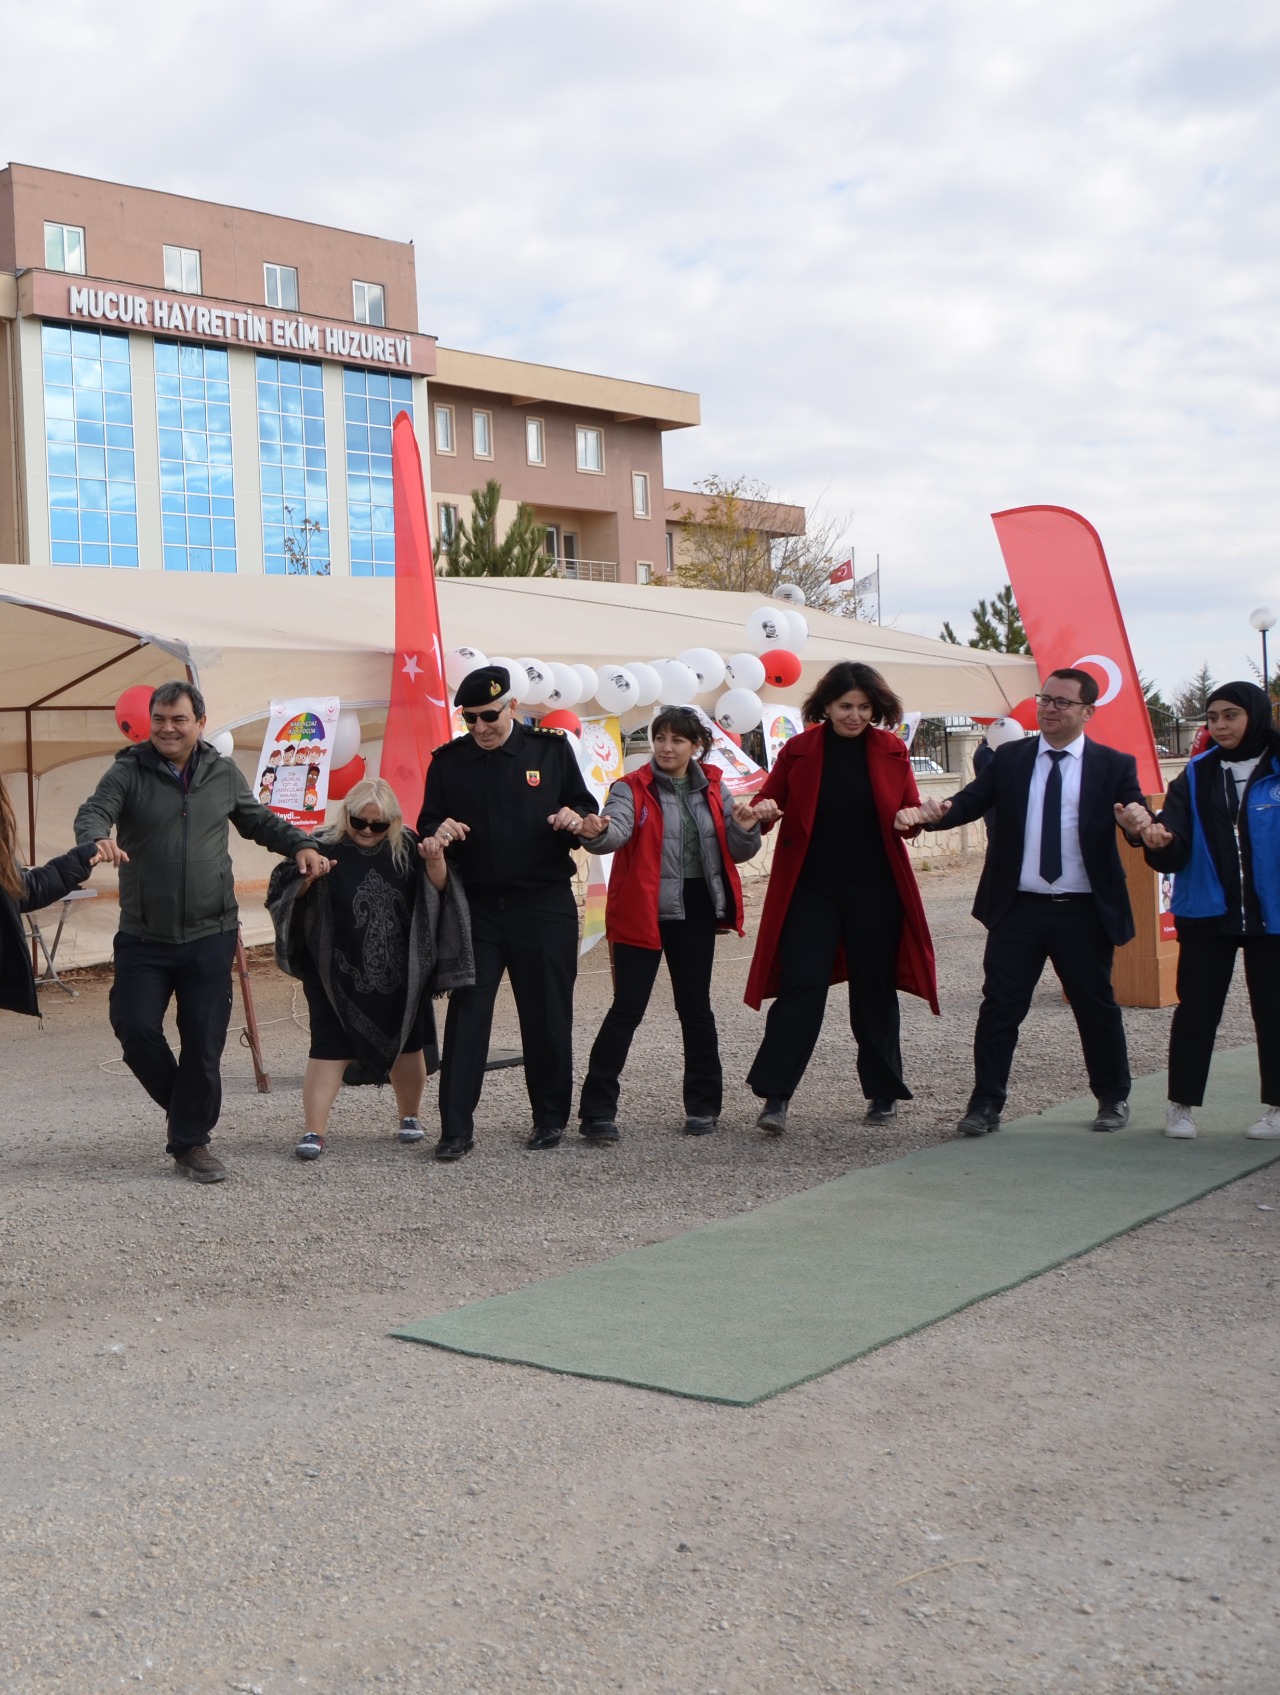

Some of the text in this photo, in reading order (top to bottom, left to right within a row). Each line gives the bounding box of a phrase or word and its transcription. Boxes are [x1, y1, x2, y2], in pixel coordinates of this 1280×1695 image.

[69, 285, 412, 366] MUCUR HAYRETTİN EKİM HUZUREVİ
